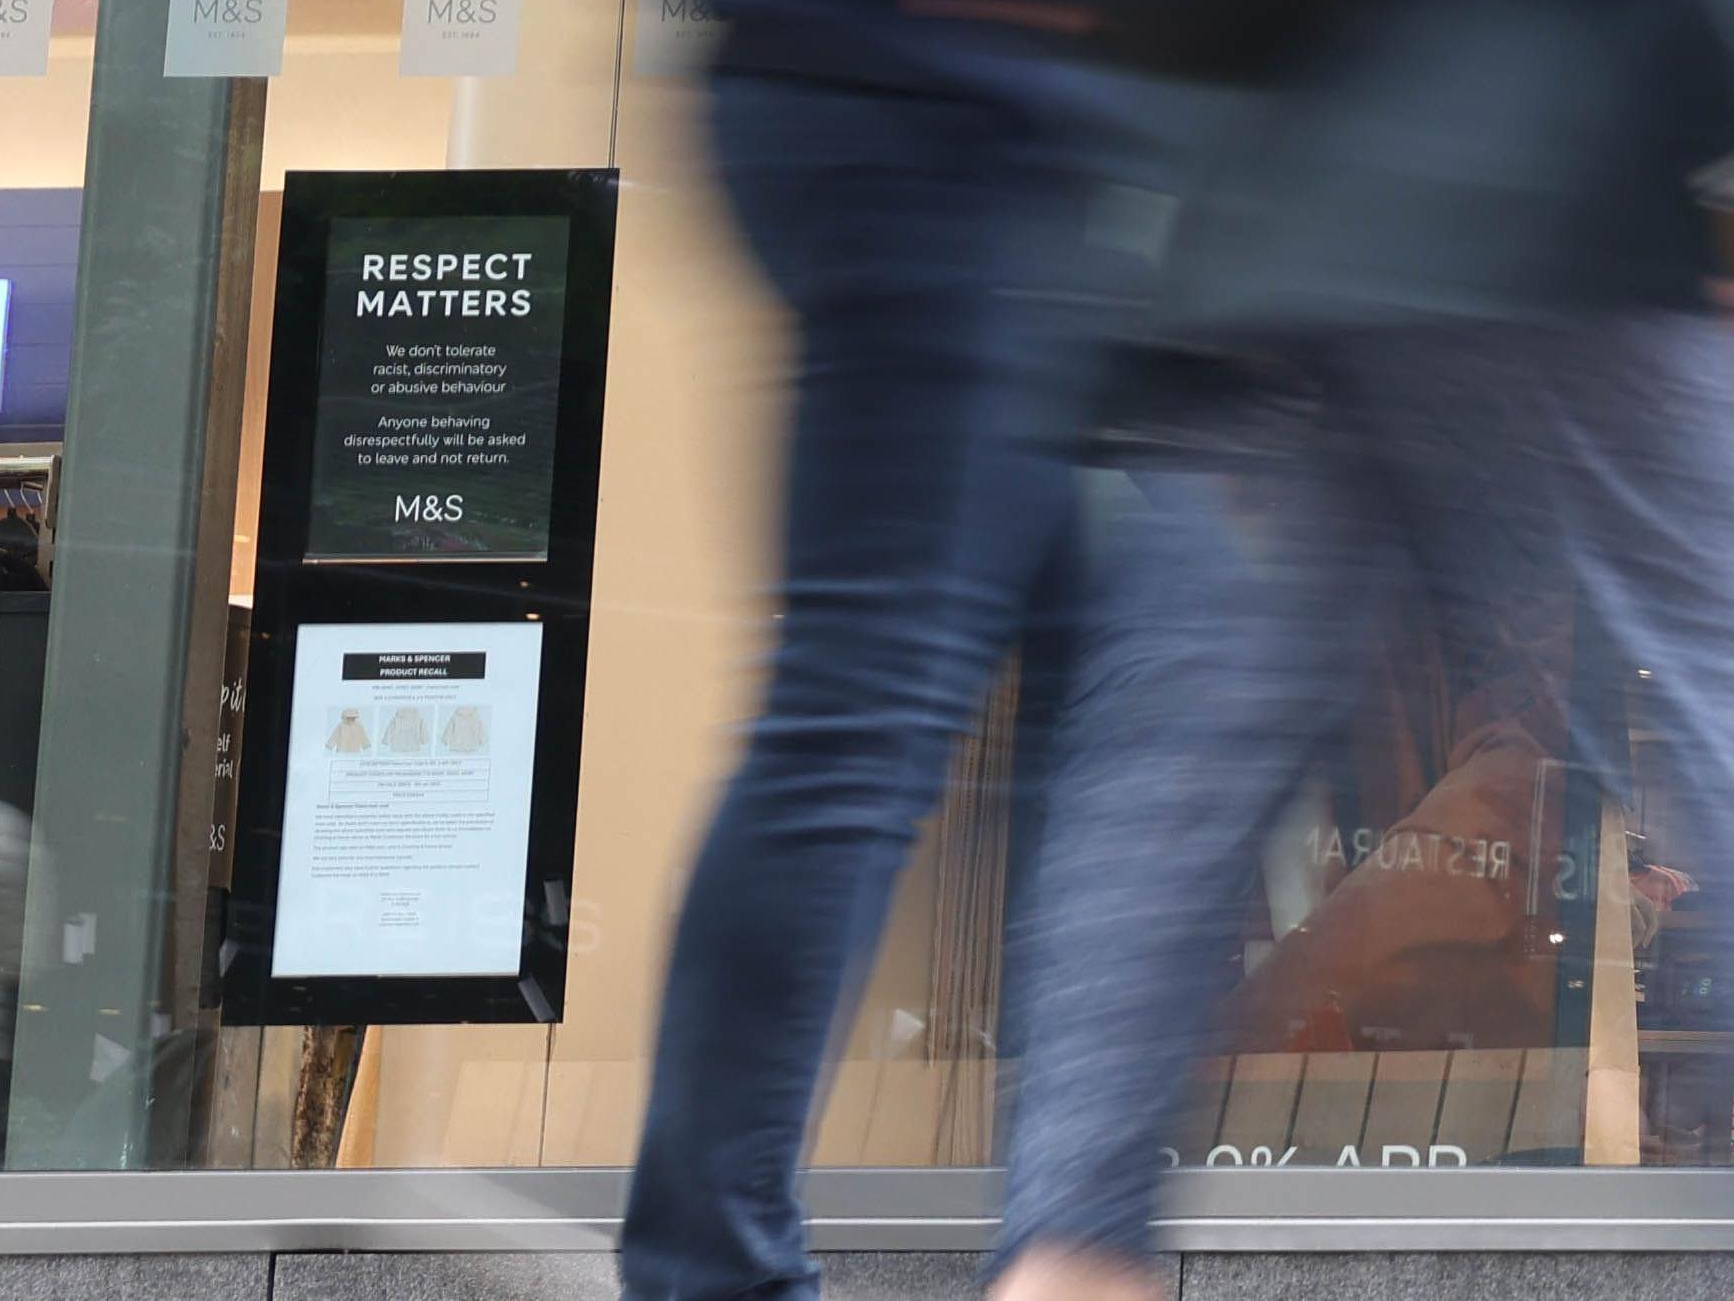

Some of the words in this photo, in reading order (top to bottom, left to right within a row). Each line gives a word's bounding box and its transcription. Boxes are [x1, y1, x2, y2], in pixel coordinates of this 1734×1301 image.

[362, 253, 533, 281] RESPECT
[356, 289, 532, 317] MATTERS
[386, 345, 405, 357] We
[408, 344, 442, 357] don't
[445, 344, 496, 357] tolerate
[373, 364, 411, 377] racist,
[414, 362, 507, 377] discriminatory
[371, 383, 385, 394] or
[388, 382, 438, 394] abusive
[441, 381, 506, 394] behaviour
[378, 416, 427, 431] Anyone
[431, 416, 490, 430] behaving
[344, 434, 439, 448] disrespectfully
[443, 434, 464, 446] will
[468, 434, 484, 446] be
[488, 433, 526, 446] asked
[358, 453, 372, 464] to
[375, 452, 408, 464] leave
[412, 452, 437, 464] and
[440, 452, 463, 464] not
[467, 452, 509, 464] return.
[394, 495, 463, 522] M&S
[379, 655, 406, 664] MARKS
[407, 655, 413, 663] &
[414, 654, 451, 663] SPENCER
[380, 668, 417, 677] PRODUCT
[418, 667, 447, 677] RECALL
[210, 824, 226, 851] &S
